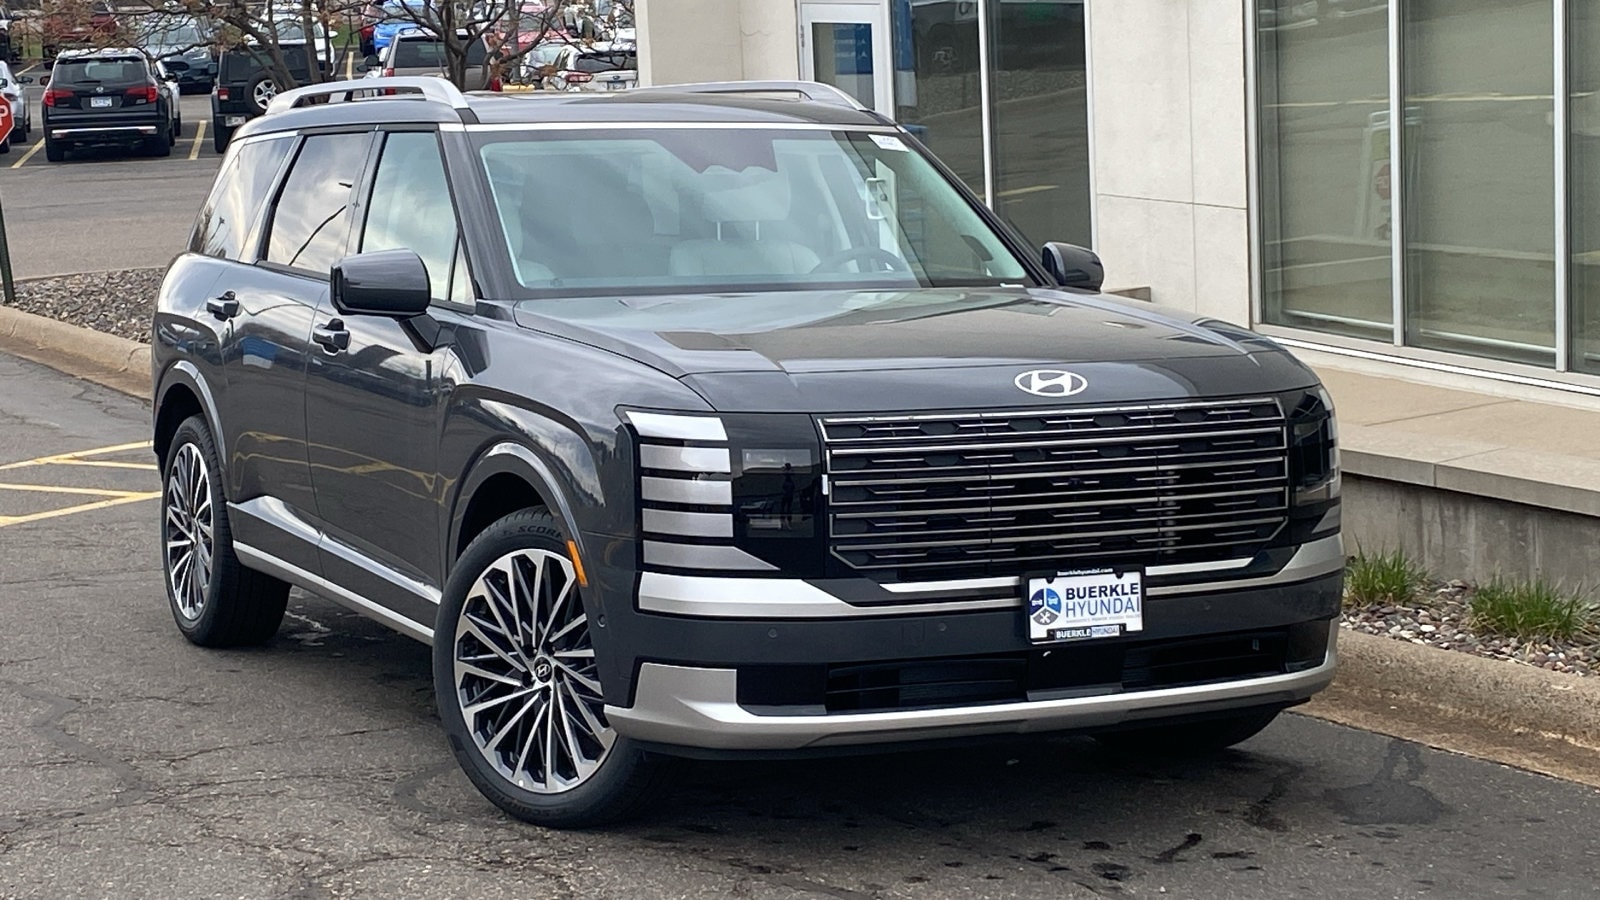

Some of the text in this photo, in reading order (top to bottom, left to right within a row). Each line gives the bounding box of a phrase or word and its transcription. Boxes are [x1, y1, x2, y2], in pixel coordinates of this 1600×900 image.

[1066, 582, 1139, 600] BUERKLE
[1066, 596, 1140, 618] HYUNDAI
[1056, 628, 1092, 639] BUERKLE
